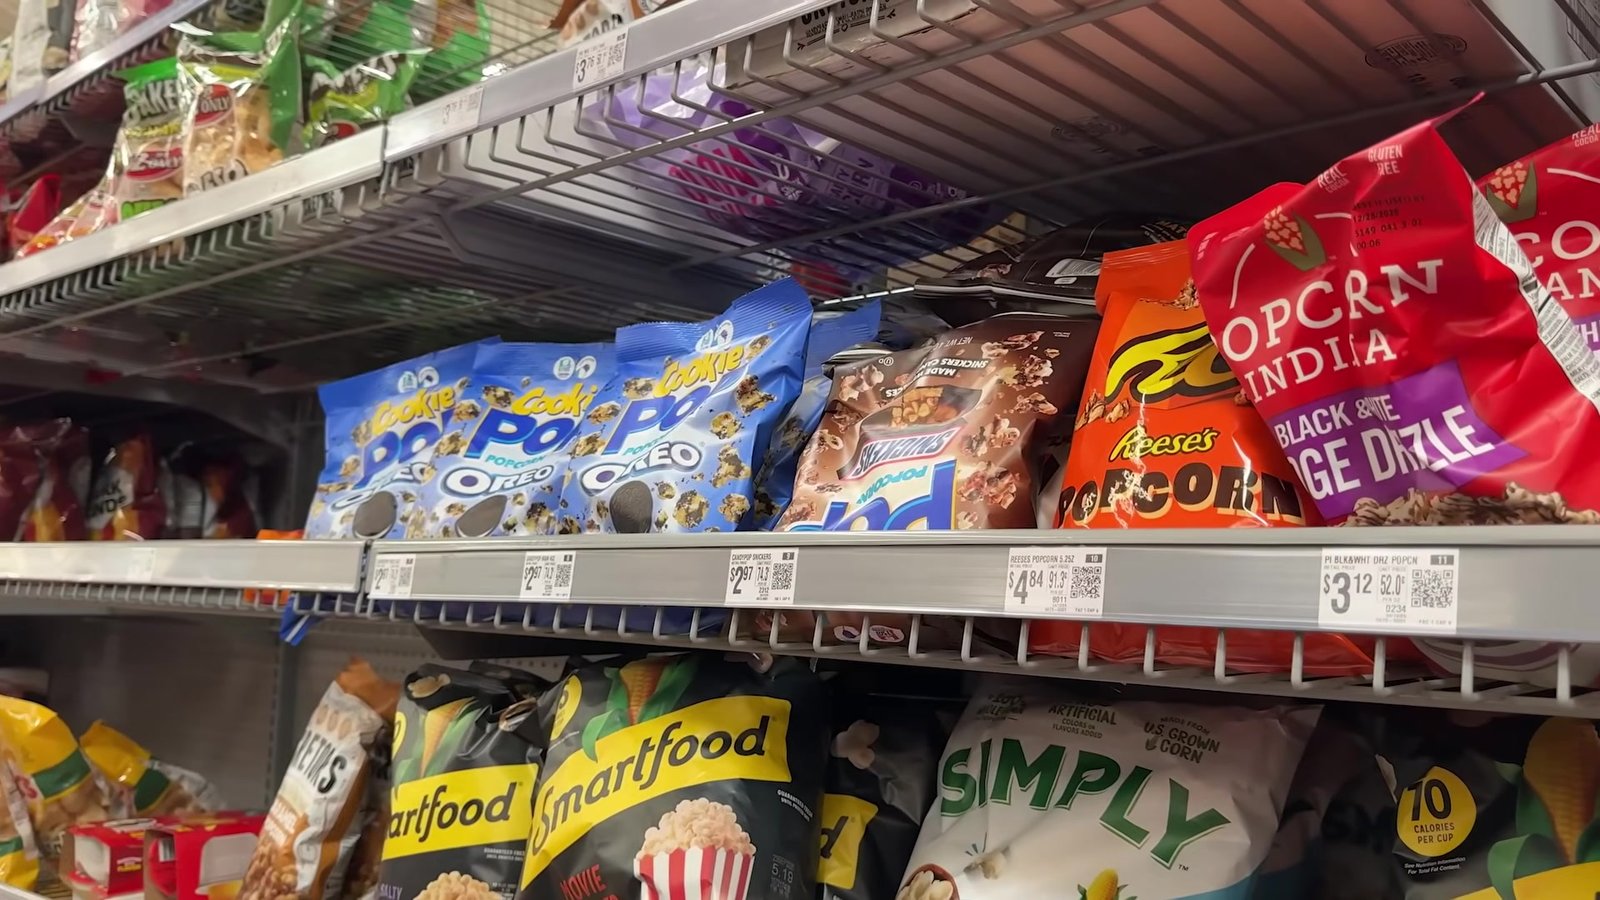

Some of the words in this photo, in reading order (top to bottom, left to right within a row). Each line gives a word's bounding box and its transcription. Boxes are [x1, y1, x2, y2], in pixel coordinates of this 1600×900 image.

[1367, 143, 1404, 162] GLUTEN
[1317, 165, 1348, 188] REAL
[652, 343, 746, 399] Cookie
[925, 366, 956, 377] MADE
[940, 357, 989, 370] SNICKERS
[371, 385, 455, 436] Cookie
[511, 382, 599, 417] Cooki
[464, 407, 577, 460] PO
[601, 384, 712, 456] PO
[1273, 401, 1353, 449] BLACK
[857, 429, 956, 476] SNICKERS
[1109, 424, 1221, 462] Reese's
[441, 464, 555, 500] OREO
[856, 464, 929, 504] POPCORN
[1058, 463, 1304, 530] POPCORN
[1010, 555, 1031, 564] REESES
[1032, 555, 1058, 564] POPCORN
[1324, 555, 1332, 565] PI
[1334, 555, 1371, 565] BLK&WHT
[1373, 555, 1389, 565] DRZ
[1391, 556, 1418, 565] POPCN
[1048, 702, 1118, 726] ARTIFICIAL
[1052, 723, 1080, 736] FLAVORS
[1080, 729, 1103, 740] ADDED
[1061, 717, 1087, 729] COLORS
[1143, 721, 1165, 738] U.S.
[1168, 728, 1221, 754] GROWN
[1160, 737, 1204, 765] CORN
[531, 714, 771, 857] Smartfood
[1406, 778, 1453, 822] 70
[386, 781, 518, 844] artfood
[940, 737, 1233, 871] SIMPLY
[1413, 821, 1456, 834] CALORIES
[1417, 833, 1434, 844] PER
[1437, 832, 1454, 843] CUP
[560, 863, 608, 900] MOVIE
